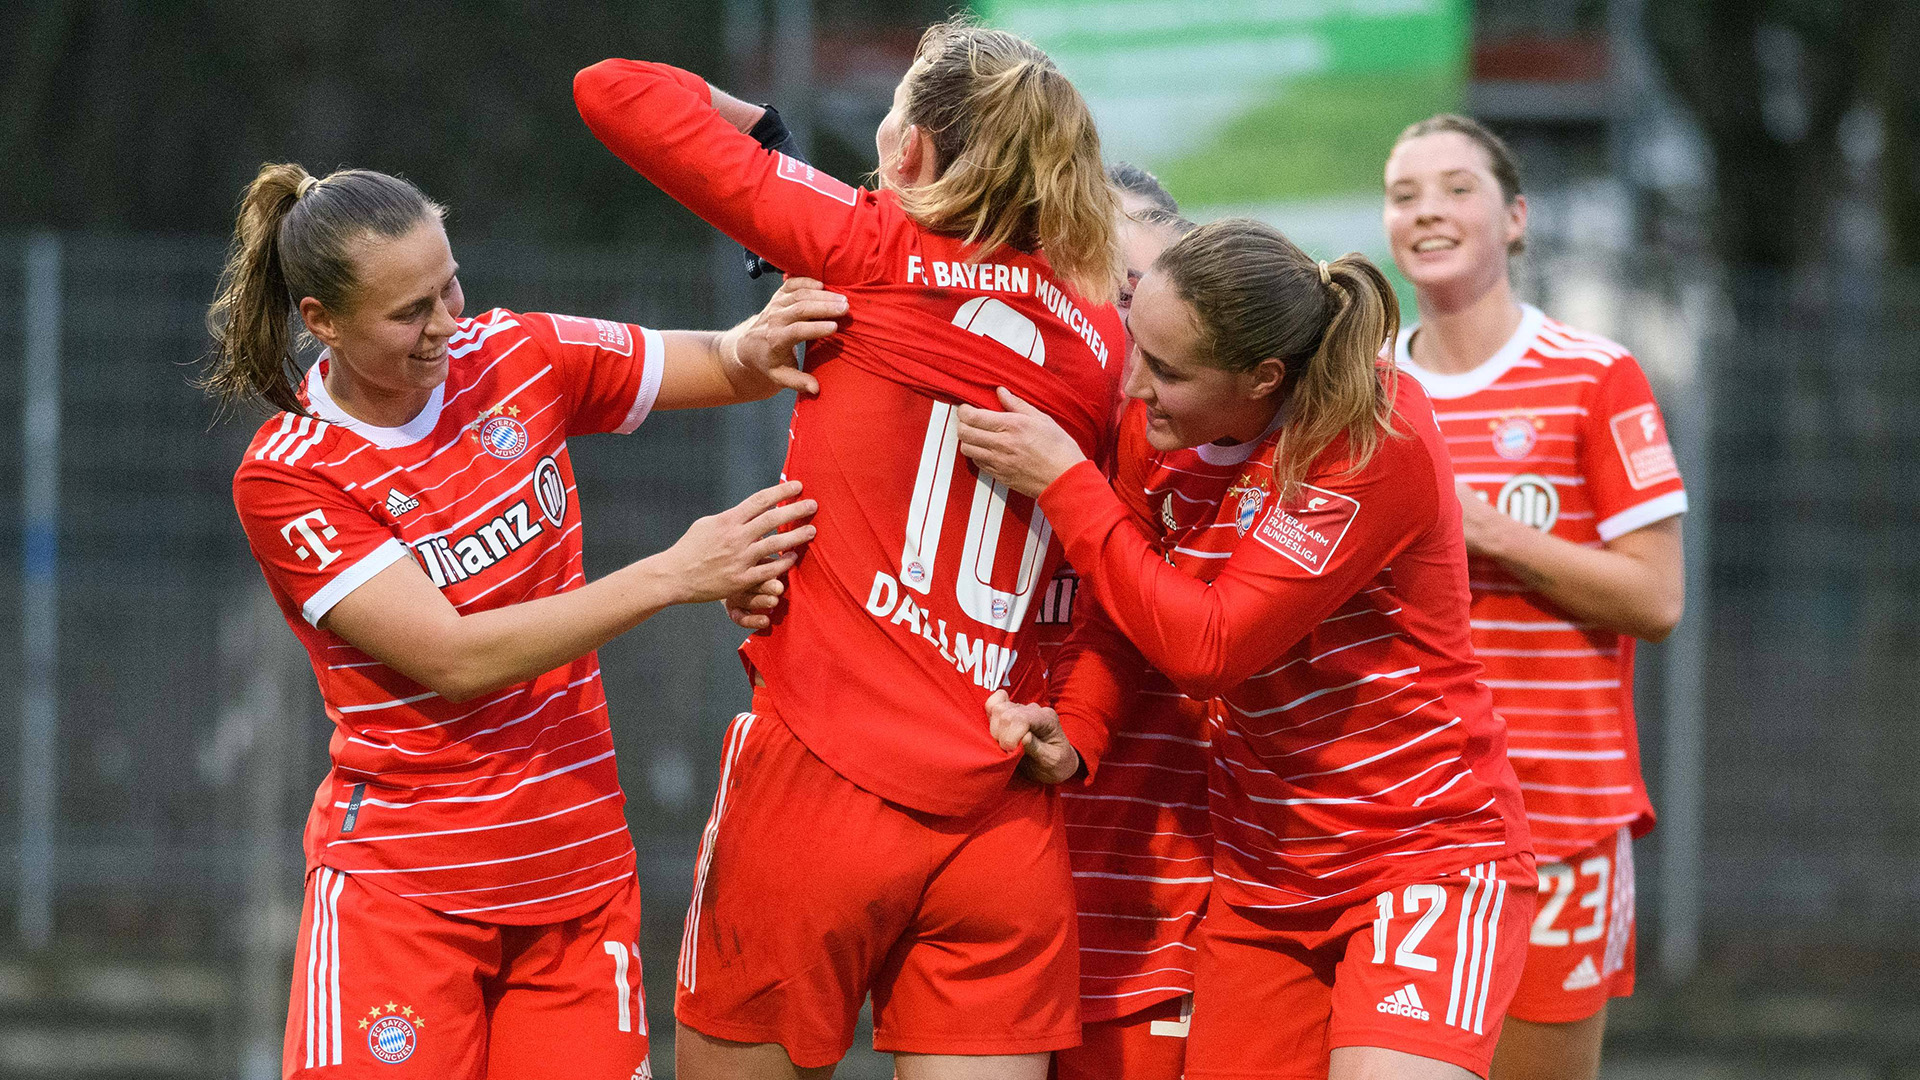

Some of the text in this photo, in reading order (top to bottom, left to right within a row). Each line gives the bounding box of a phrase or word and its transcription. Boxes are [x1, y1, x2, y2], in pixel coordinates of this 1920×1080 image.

[932, 261, 1029, 293] BAYERN
[1035, 273, 1109, 370] MÜNCHEN
[486, 420, 515, 434] BAYERN
[494, 431, 525, 456] MÜNCHEN
[1268, 516, 1307, 542] FRAUEN-
[1274, 508, 1330, 547] FLYERALARM
[1262, 525, 1318, 565] BUNDESLIGA
[1529, 856, 1611, 946] 23
[1372, 884, 1447, 972] 12
[1376, 1001, 1430, 1022] adidas
[381, 1020, 412, 1037] BAYERN
[373, 1044, 412, 1061] MÜNCHEN
